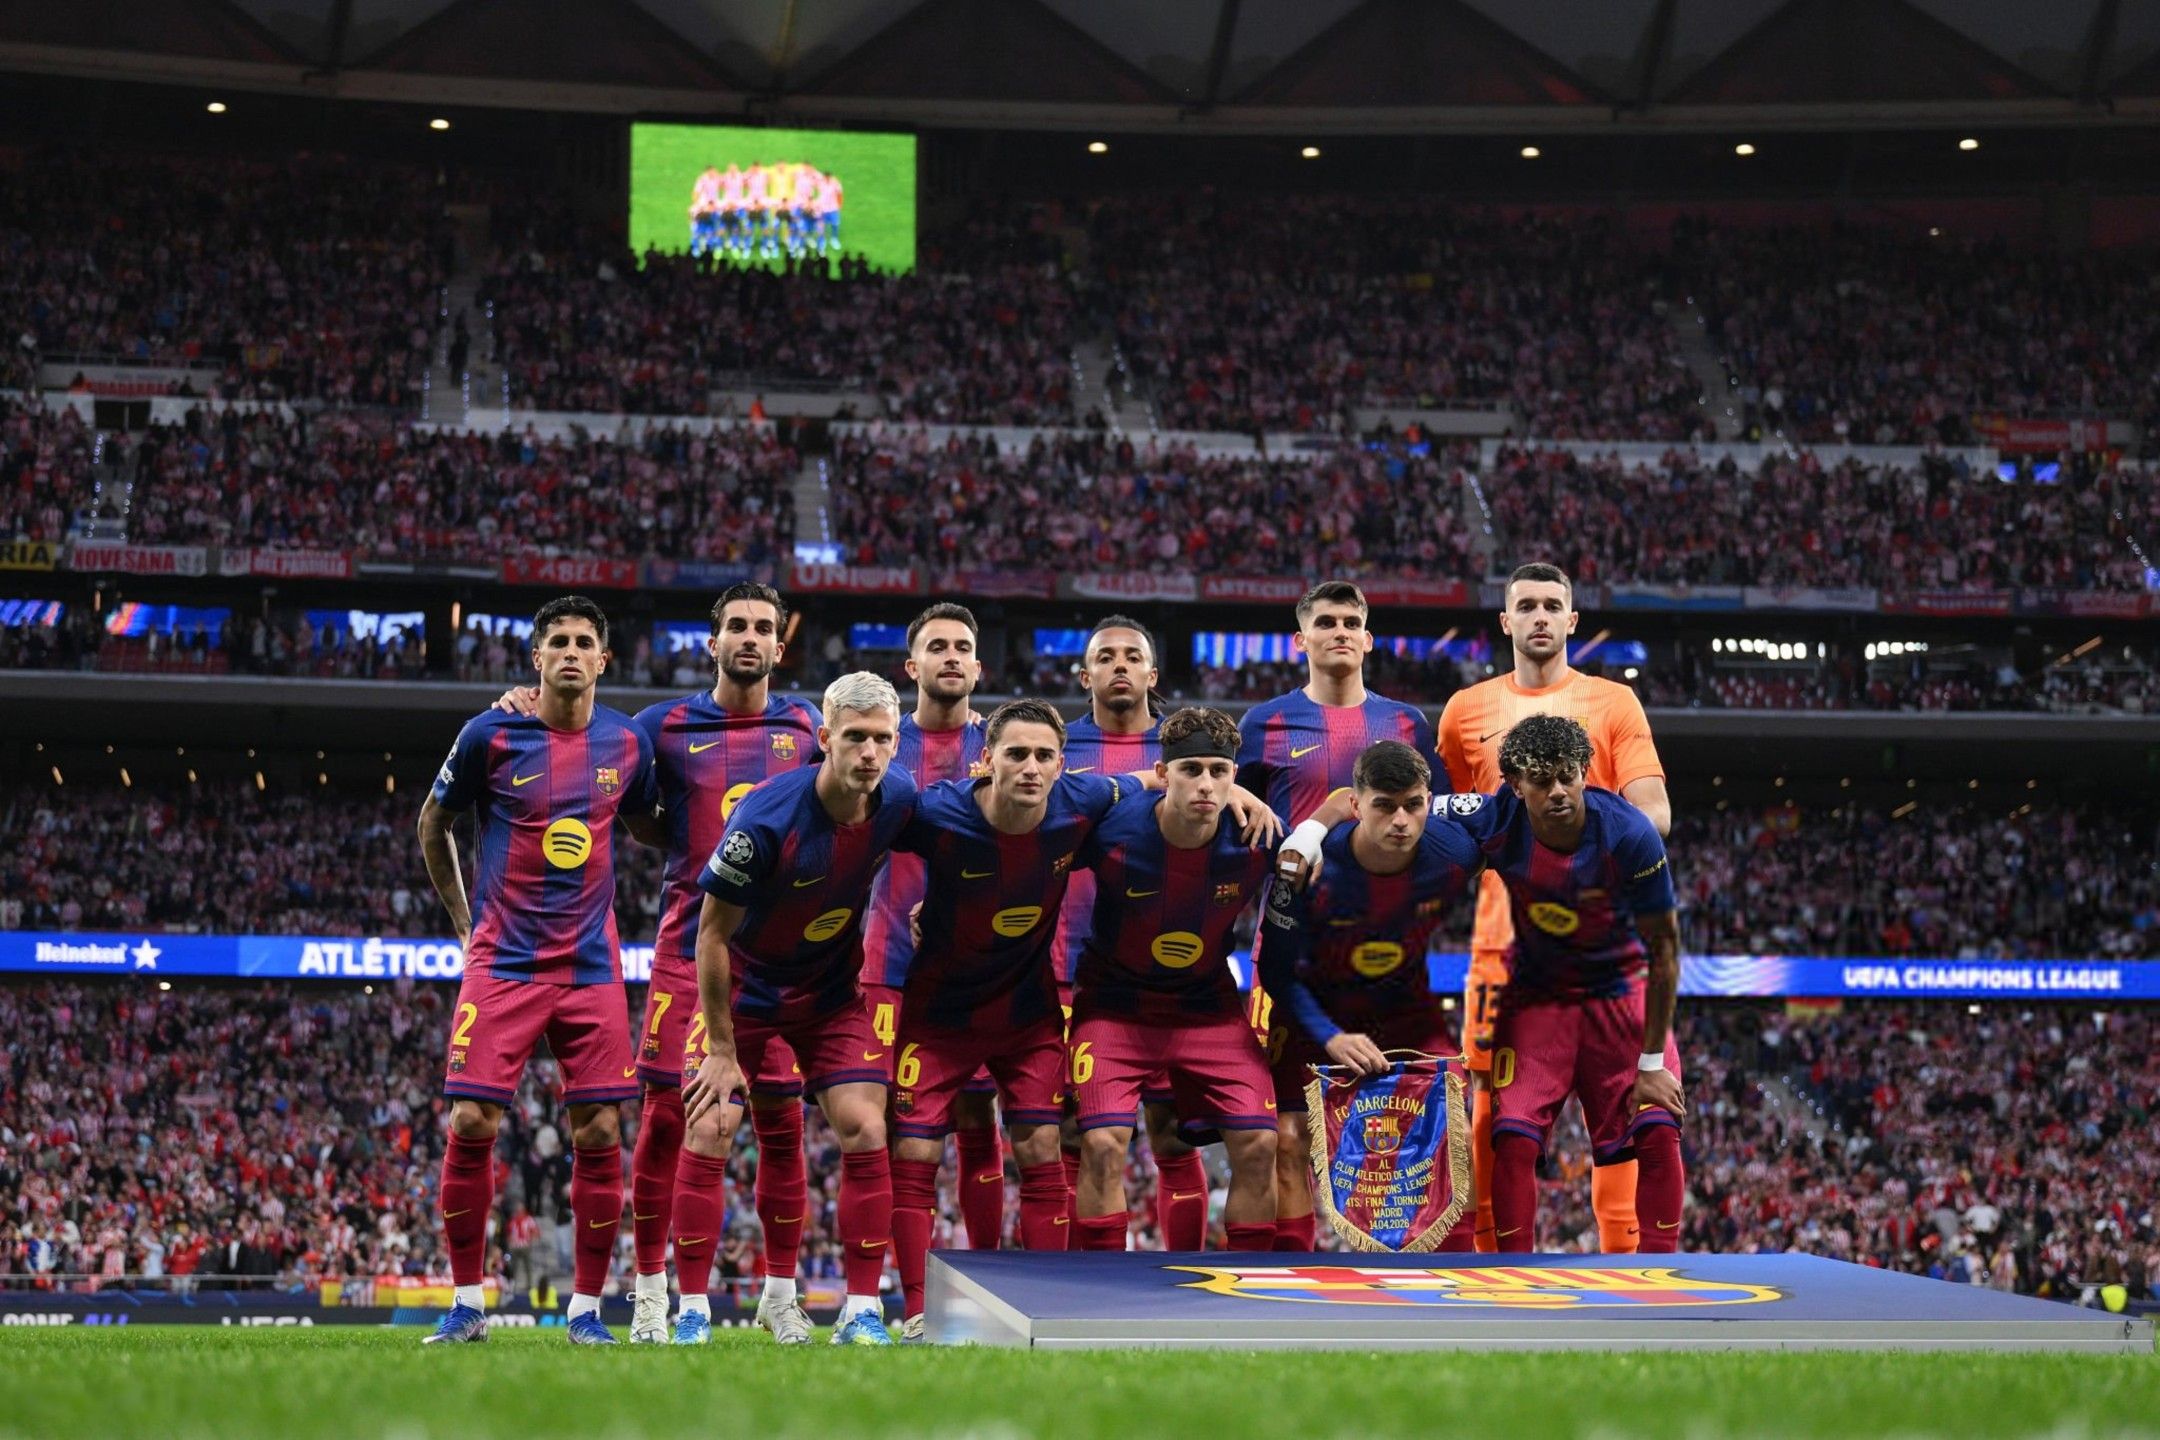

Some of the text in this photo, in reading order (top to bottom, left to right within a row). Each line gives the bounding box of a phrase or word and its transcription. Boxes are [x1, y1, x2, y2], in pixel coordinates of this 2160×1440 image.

[35, 941, 128, 964] Heineken
[298, 937, 465, 977] ATLÉTICO
[1843, 966, 2122, 990] UEFA CHAMPIONS LEAGUE
[452, 1002, 478, 1047] 2
[649, 991, 673, 1035] 7
[897, 1042, 921, 1088] 6
[1334, 1095, 1426, 1123] FC BARCELONA
[1334, 1157, 1434, 1182] CLUB ATLETICO DE MADRID
[1378, 1159, 1392, 1170] AL
[1333, 1172, 1436, 1196] UEFA CHAMPIONS LEAGUE
[1365, 1197, 1390, 1208] FINAL
[1373, 1207, 1403, 1219] MADRID
